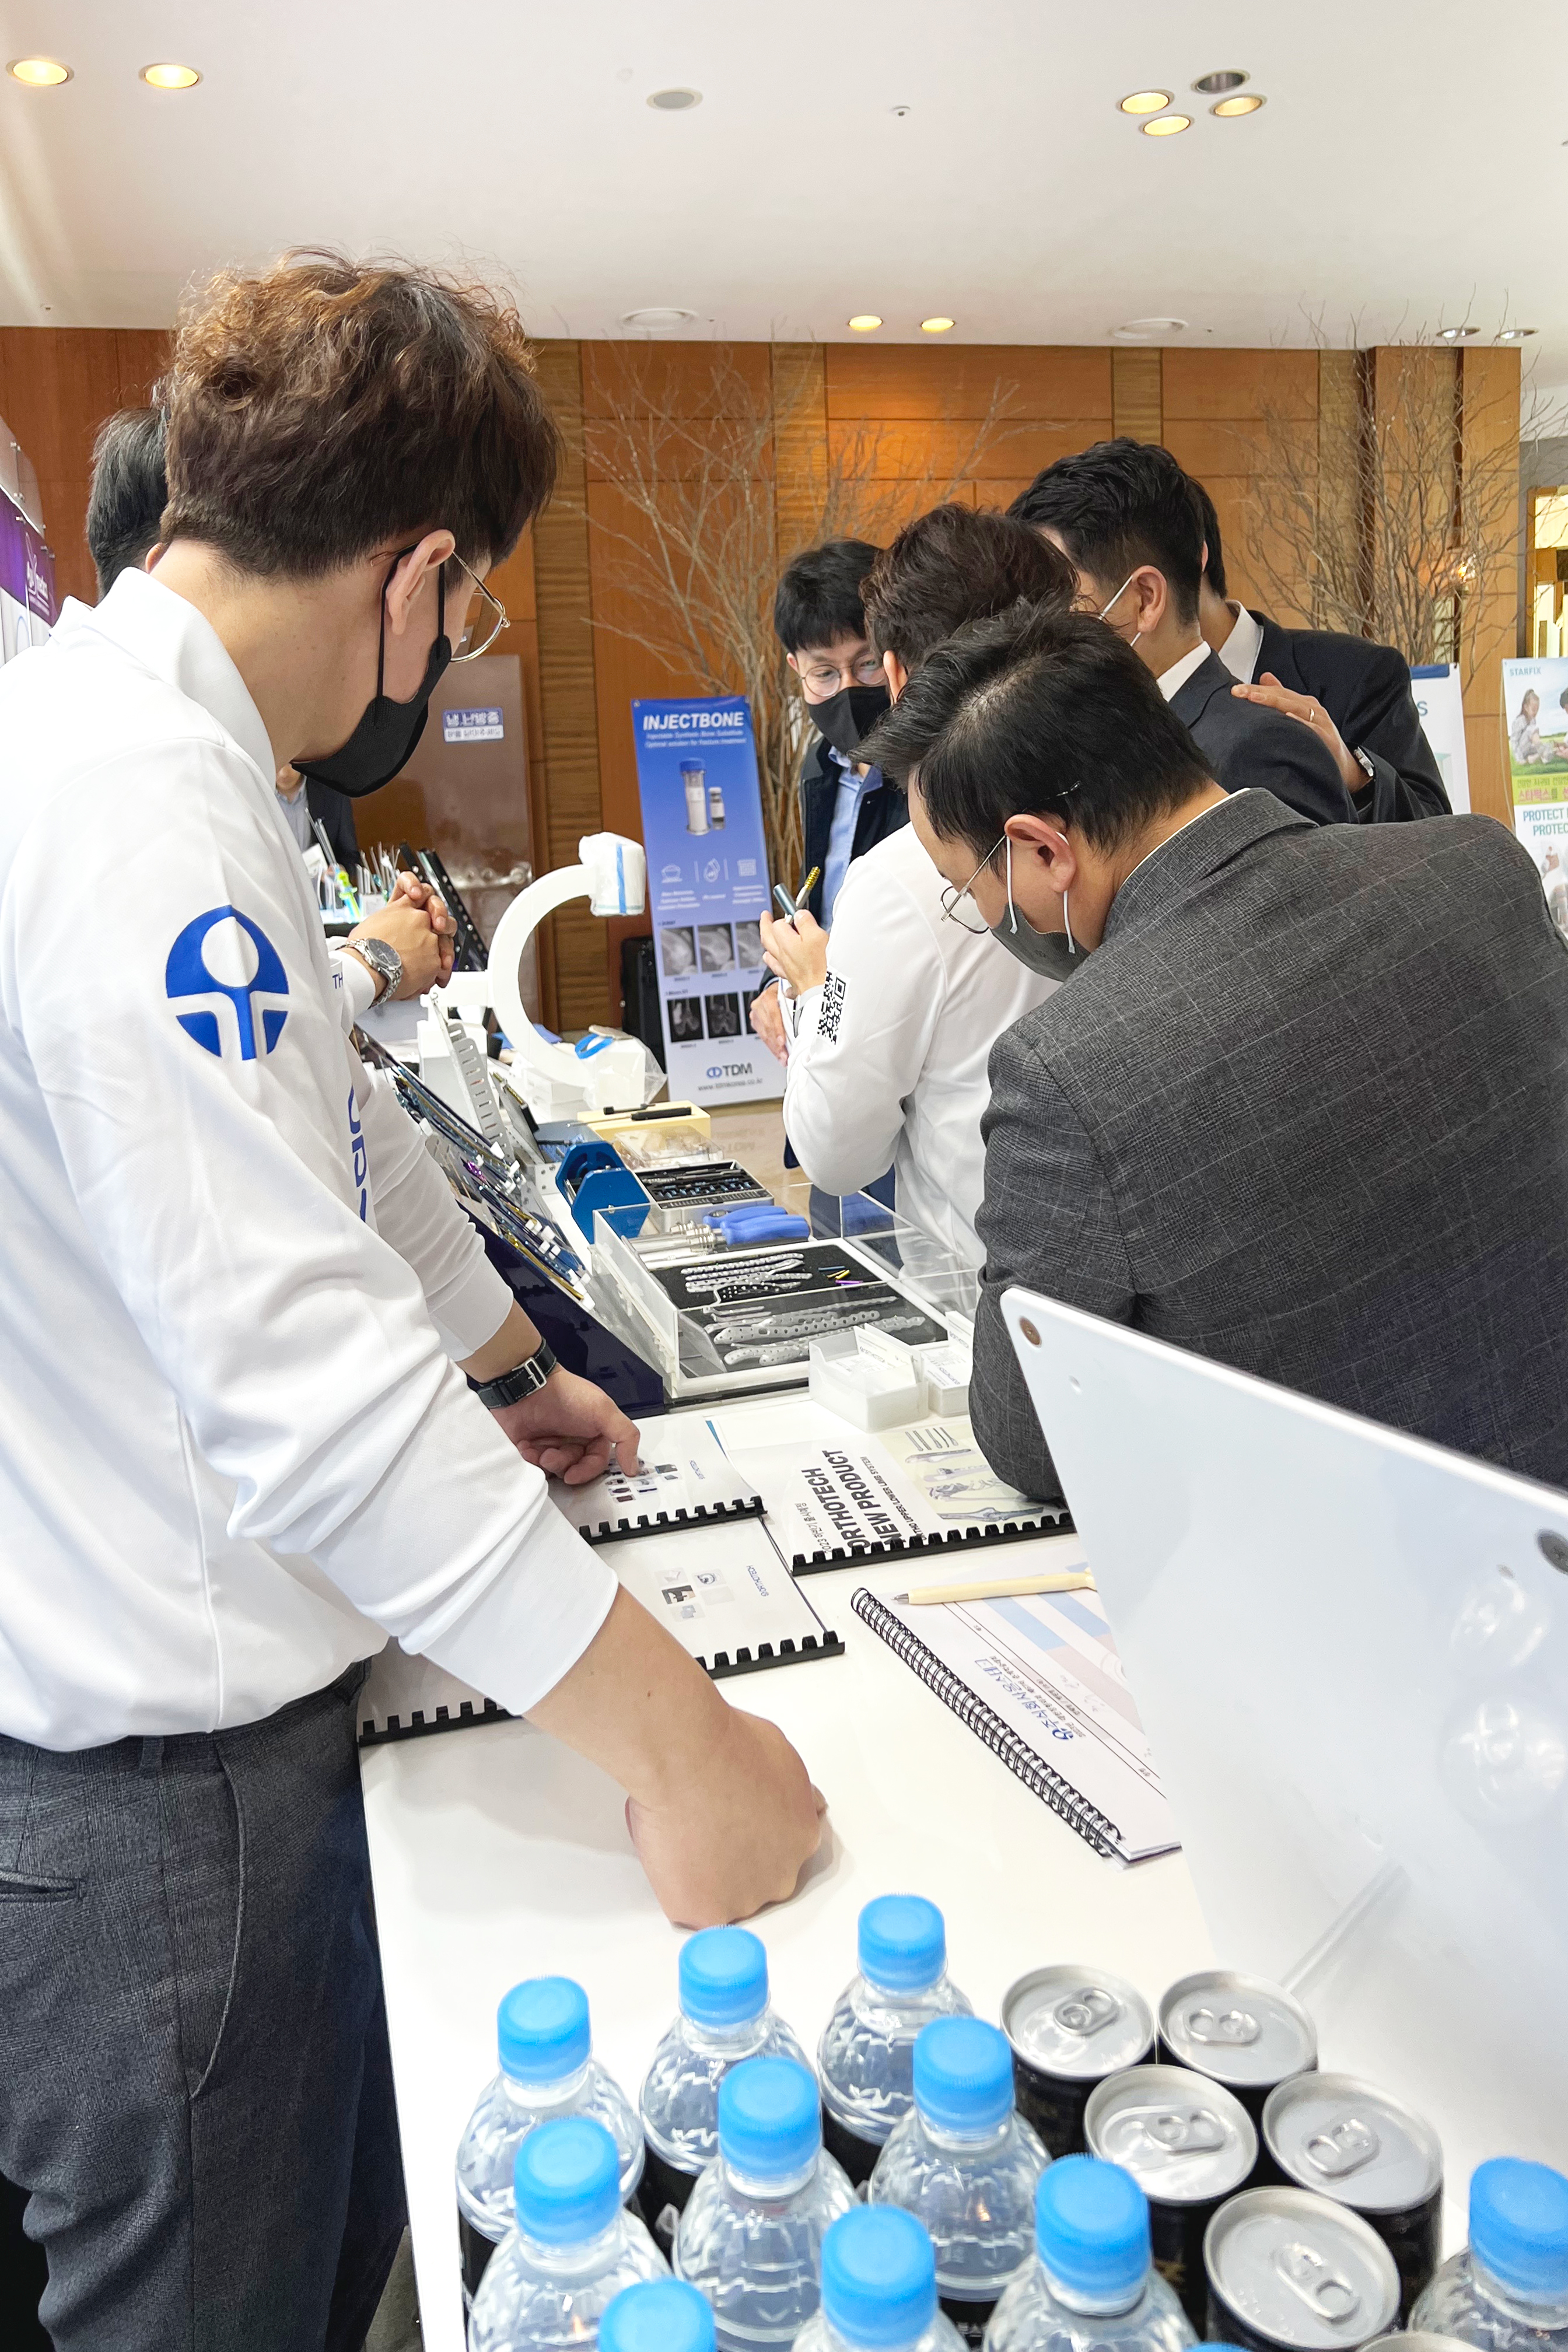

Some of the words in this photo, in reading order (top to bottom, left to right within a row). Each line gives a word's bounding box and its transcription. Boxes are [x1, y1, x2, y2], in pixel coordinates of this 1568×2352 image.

[1510, 667, 1542, 676] STARFIX
[643, 711, 744, 730] INJECTBONE
[1523, 807, 1564, 821] PROTECT
[722, 1062, 753, 1076] TDM
[860, 1456, 878, 1475] SYSTEM
[822, 1450, 881, 1511] PRODUCT
[873, 1475, 888, 1487] LIMB
[801, 1467, 870, 1548] ORTHOTECH
